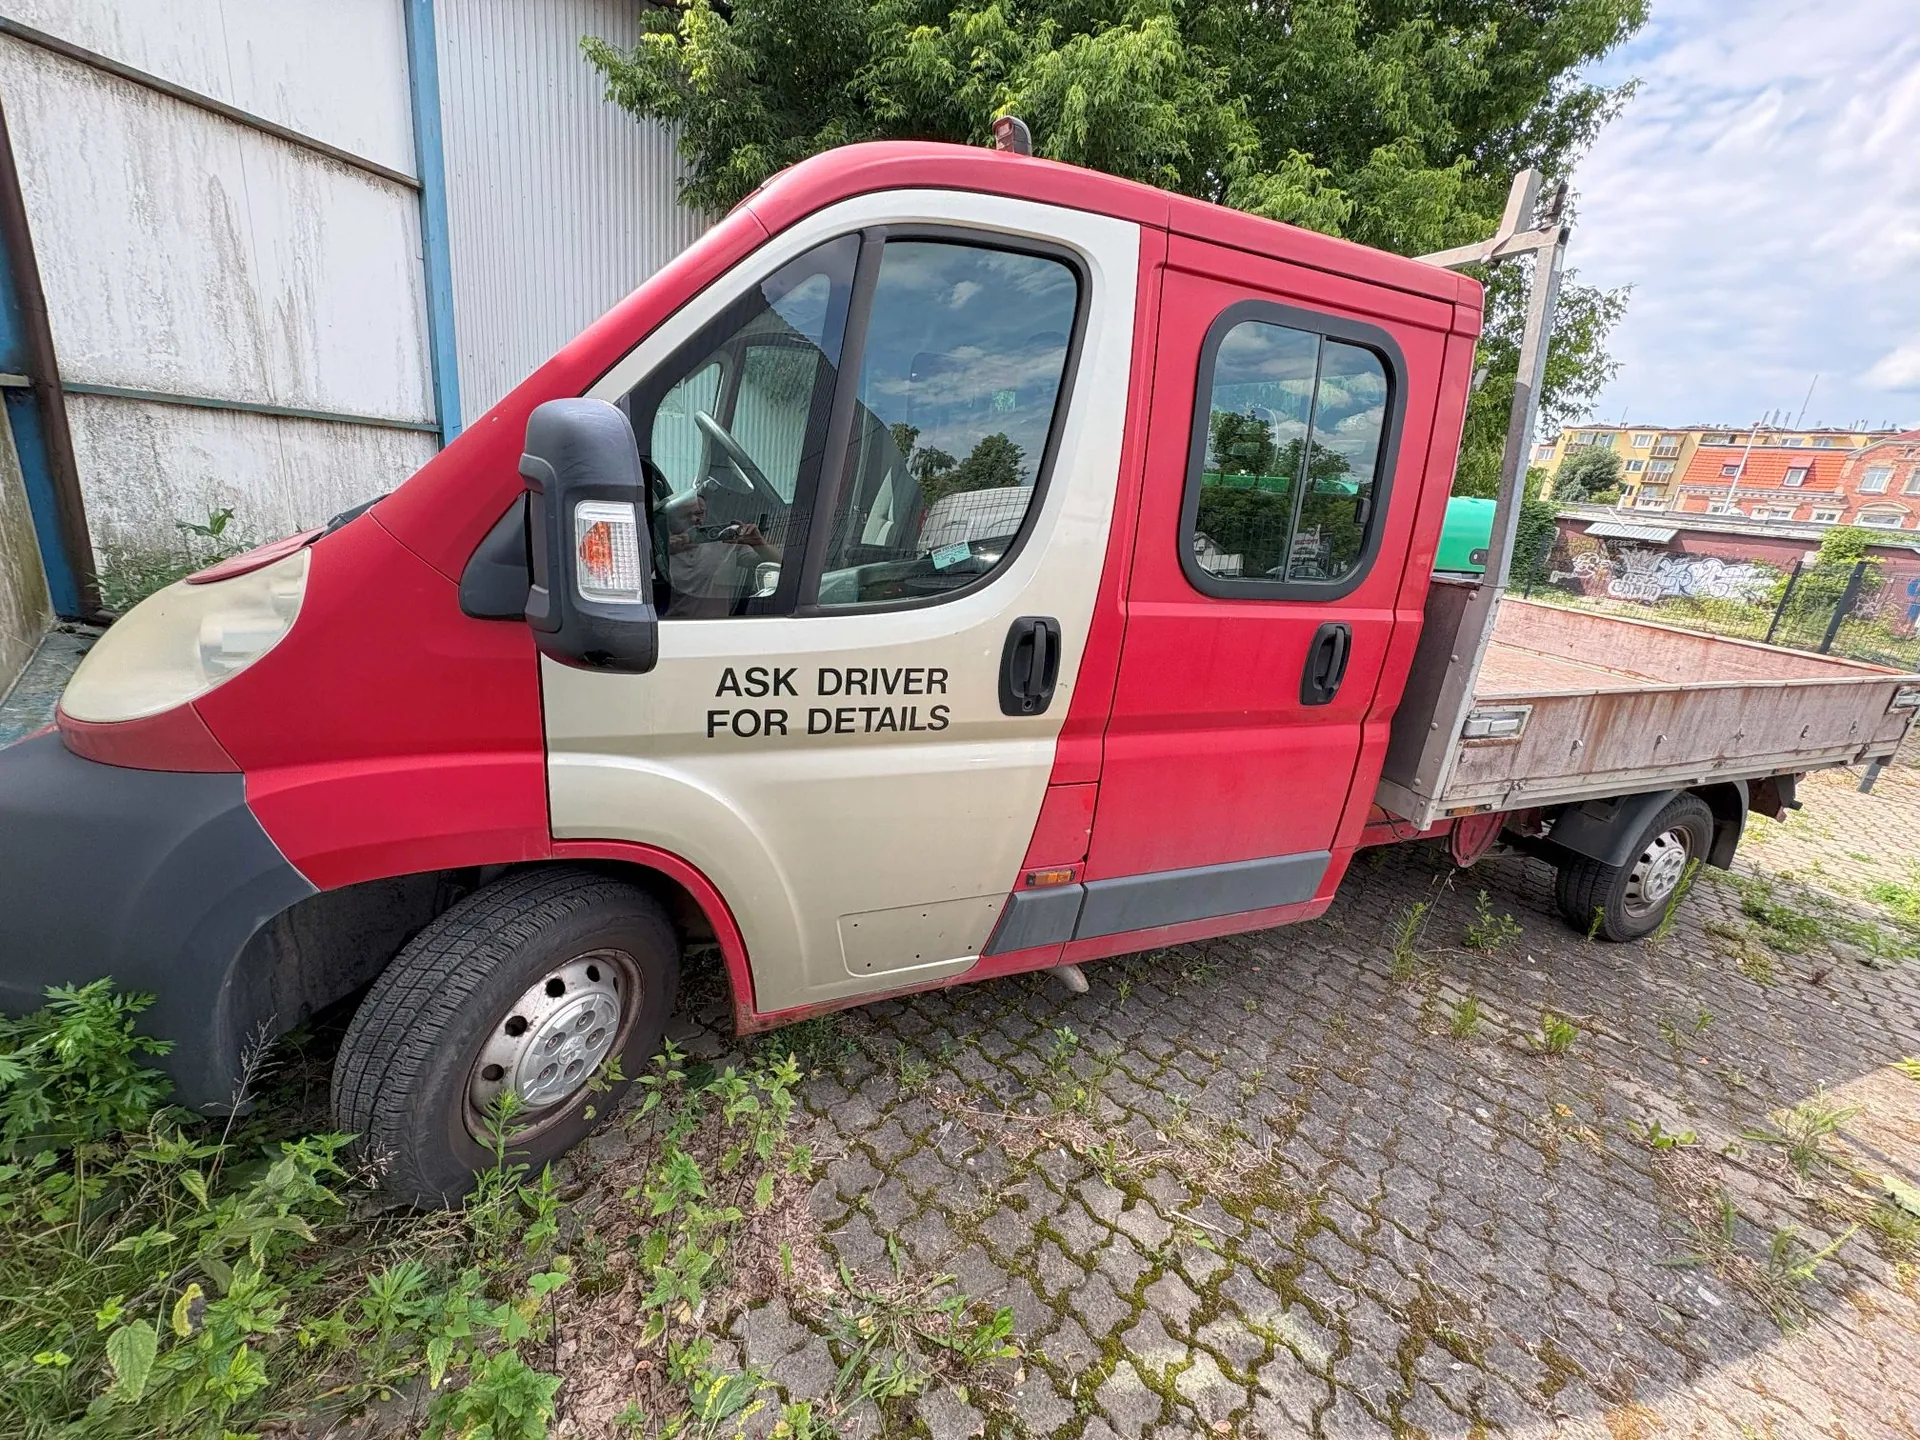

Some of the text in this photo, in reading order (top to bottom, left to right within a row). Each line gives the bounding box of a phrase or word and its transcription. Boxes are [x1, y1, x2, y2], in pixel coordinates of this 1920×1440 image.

[715, 667, 949, 698] ASK DRIVER
[707, 704, 950, 738] FOR DETAILS
